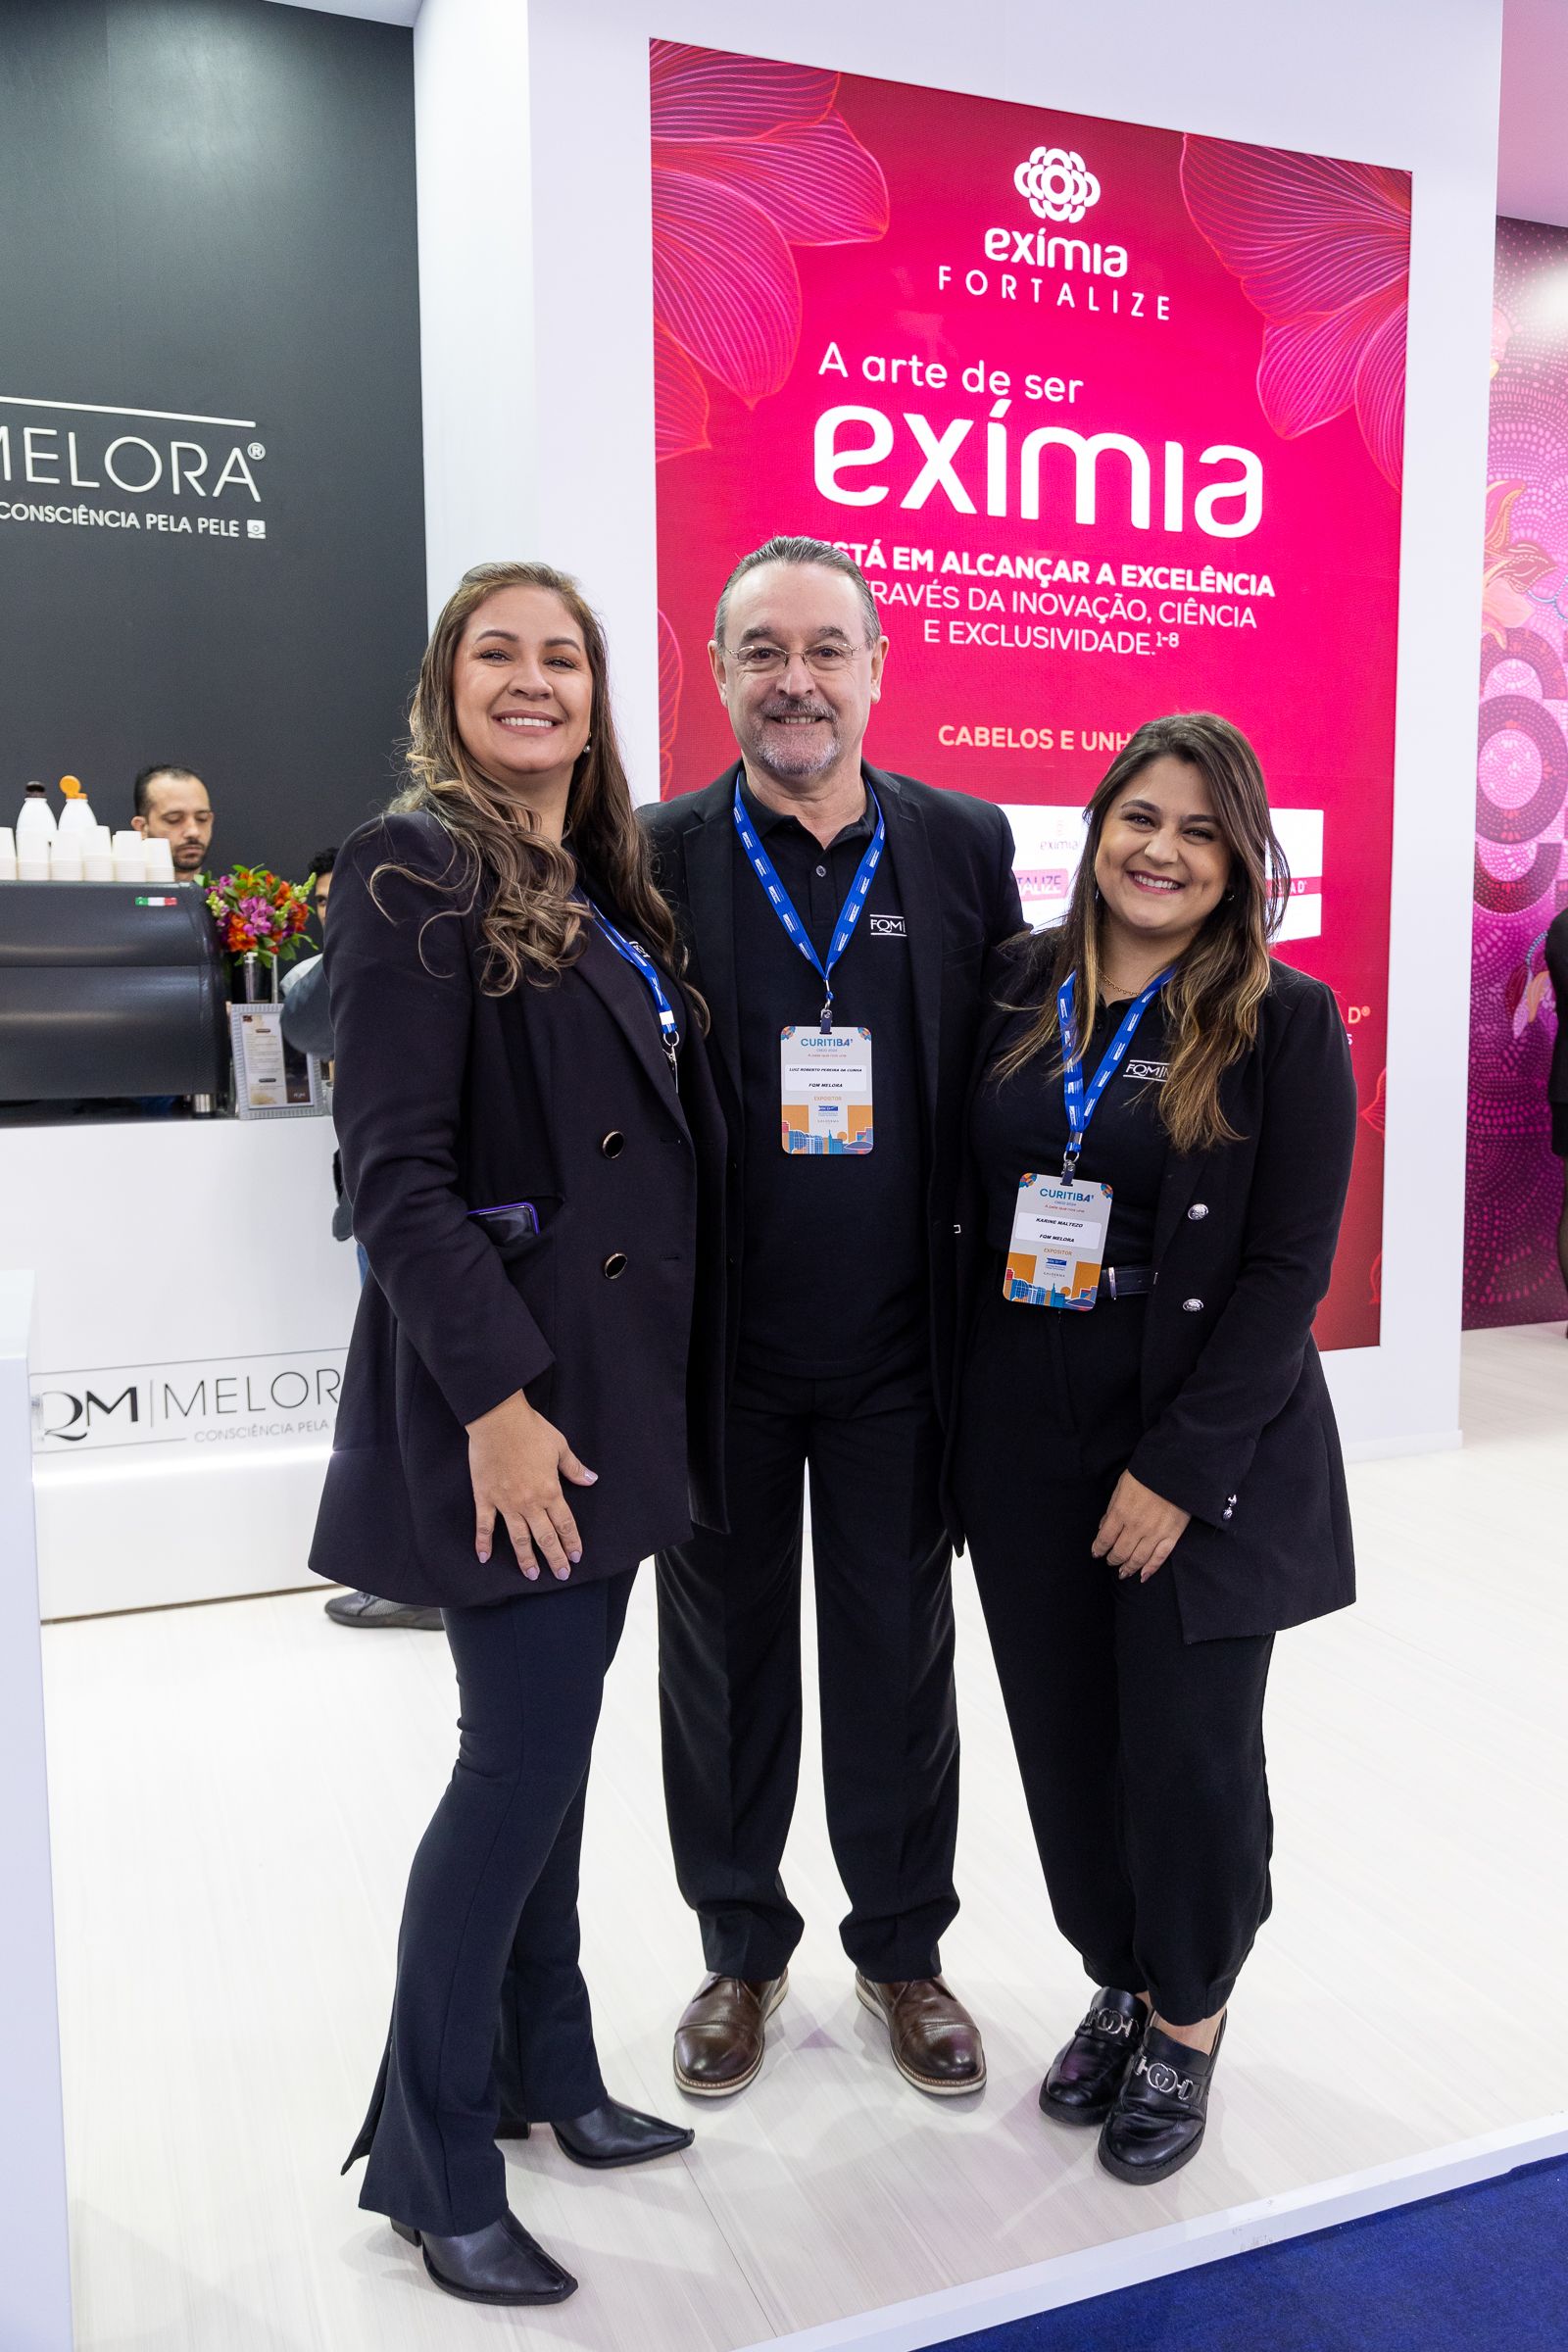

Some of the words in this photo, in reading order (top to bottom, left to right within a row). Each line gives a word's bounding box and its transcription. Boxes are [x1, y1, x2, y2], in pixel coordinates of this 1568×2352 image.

[984, 227, 1128, 278] exímia
[938, 266, 1171, 320] FORTALIZE
[818, 341, 849, 378] A
[861, 354, 948, 389] arte
[961, 360, 1011, 396] de
[1024, 373, 1085, 404] ser
[812, 398, 1264, 539] exímia
[0, 501, 141, 530] CONSCIÊNCIA
[145, 513, 193, 534] PELA
[197, 516, 240, 538] PELE
[892, 546, 934, 573] EM
[940, 550, 1091, 588] ALCANÇAR
[1095, 562, 1117, 586] A
[1120, 564, 1277, 598] EXCELÊNCIA
[923, 618, 941, 643] E
[967, 587, 1005, 613] DA
[1011, 590, 1152, 624] INOVAÇÃO,
[1158, 596, 1258, 629] CIÊNCIA
[937, 724, 1054, 751] CABELOS
[1059, 729, 1075, 751] E
[194, 1422, 295, 1444] CONSCIÊNCIA
[297, 1418, 330, 1434] PELA
